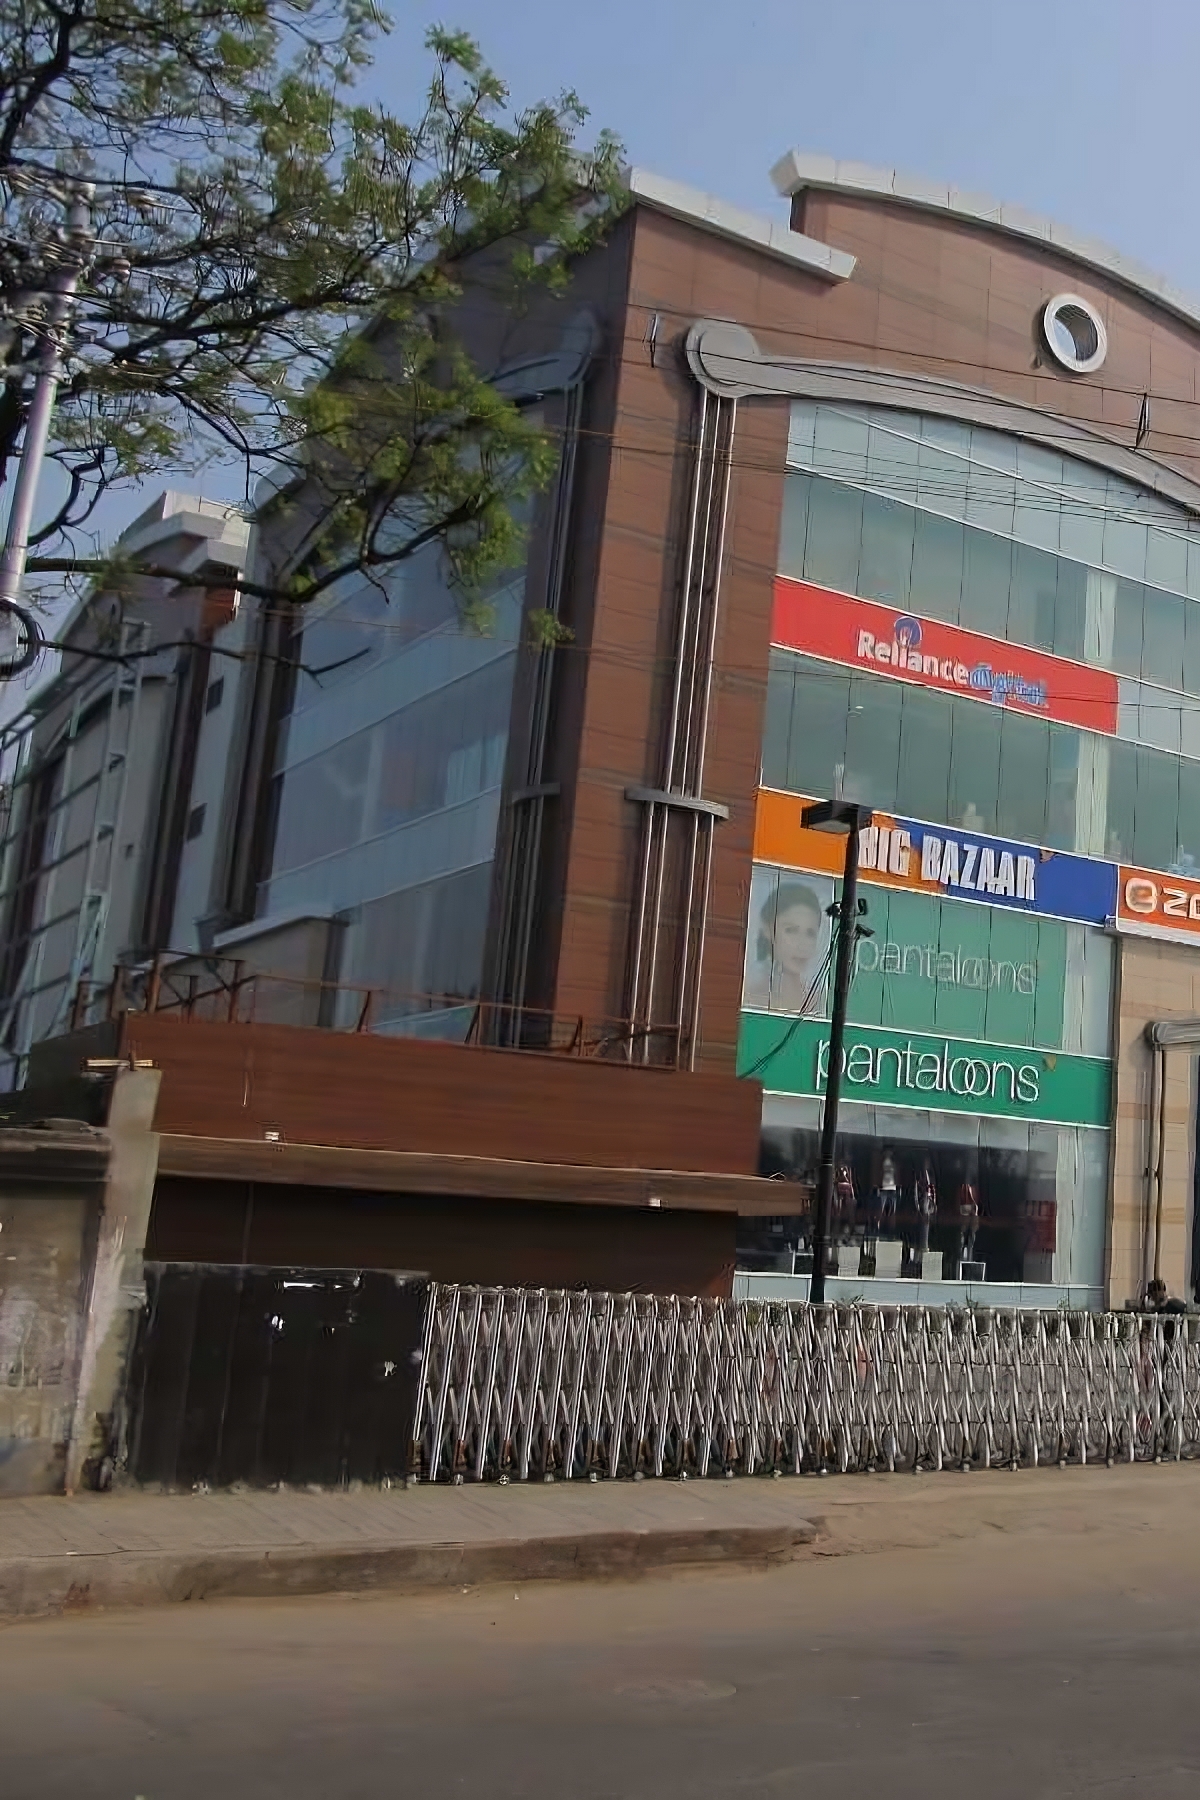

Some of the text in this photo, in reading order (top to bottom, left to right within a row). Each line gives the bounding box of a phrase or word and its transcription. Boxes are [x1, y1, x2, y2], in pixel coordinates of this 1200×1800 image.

[856, 627, 970, 684] Reliance
[858, 827, 1036, 900] BIG BAZAAR
[852, 940, 1034, 994] pantaloons
[816, 1039, 1040, 1102] pantaloons
